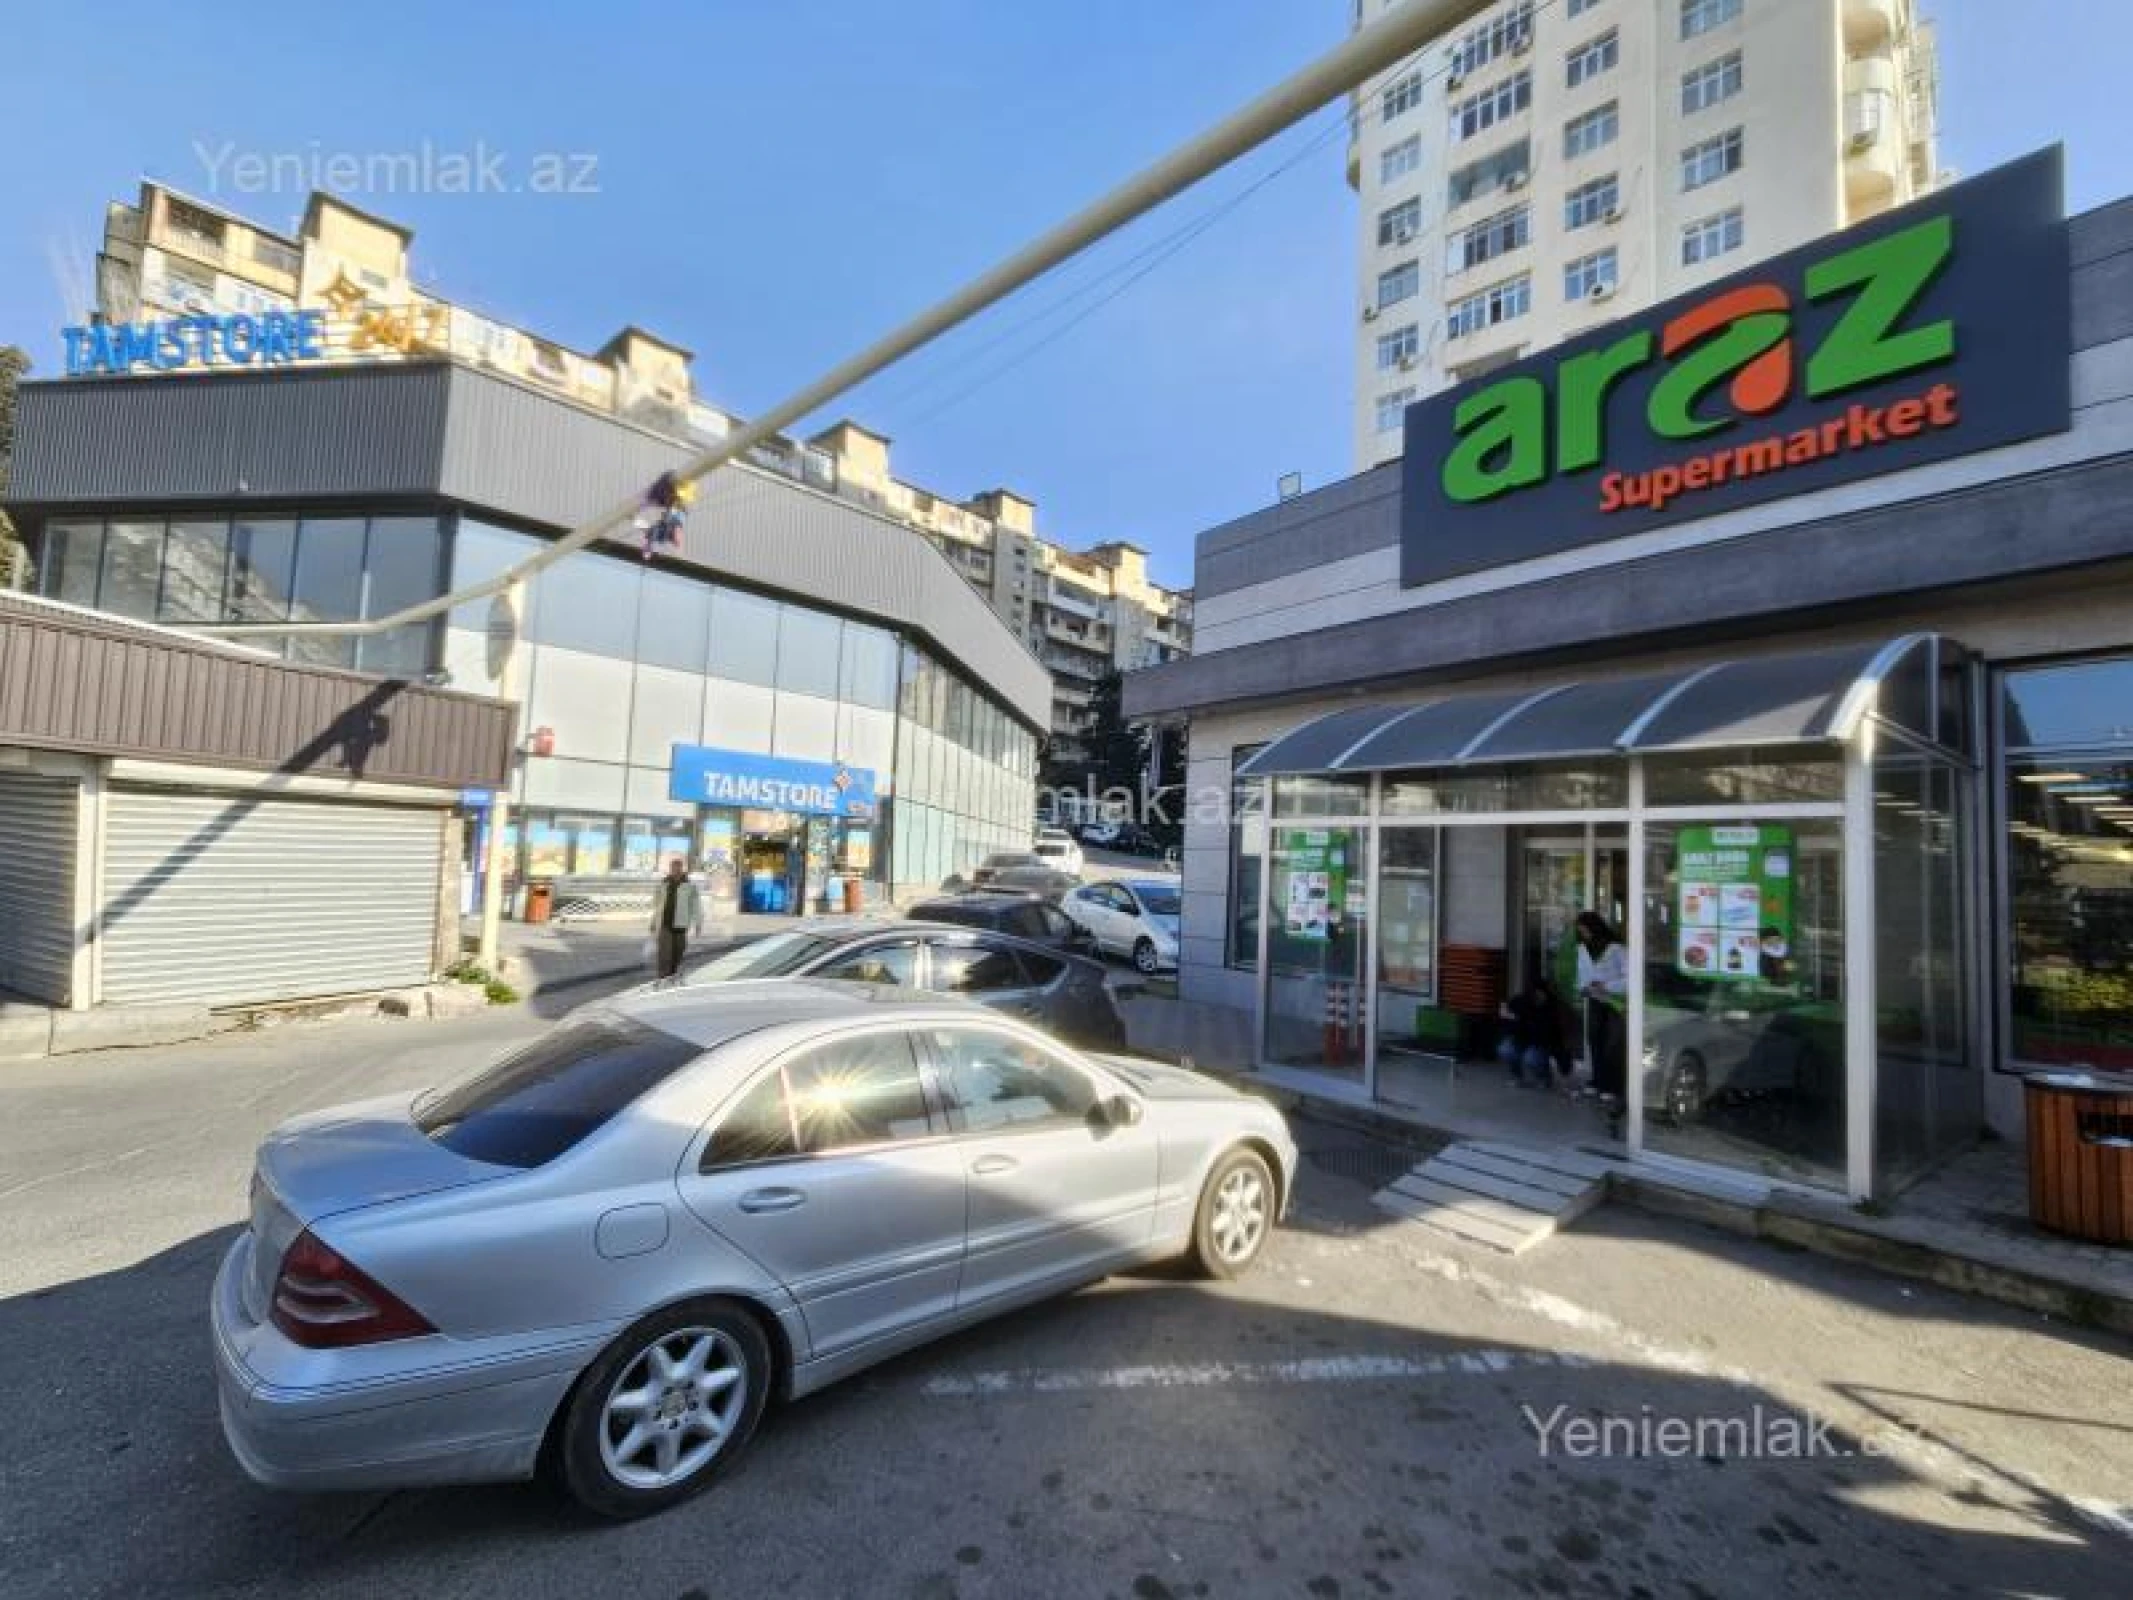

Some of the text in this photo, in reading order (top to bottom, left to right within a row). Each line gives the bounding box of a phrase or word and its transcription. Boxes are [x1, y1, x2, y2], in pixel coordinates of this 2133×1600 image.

[61, 308, 326, 376] TAMSTORE
[1441, 214, 1954, 504] araz
[1600, 383, 1957, 512] Supermarket
[704, 770, 838, 810] TAMSTORE
